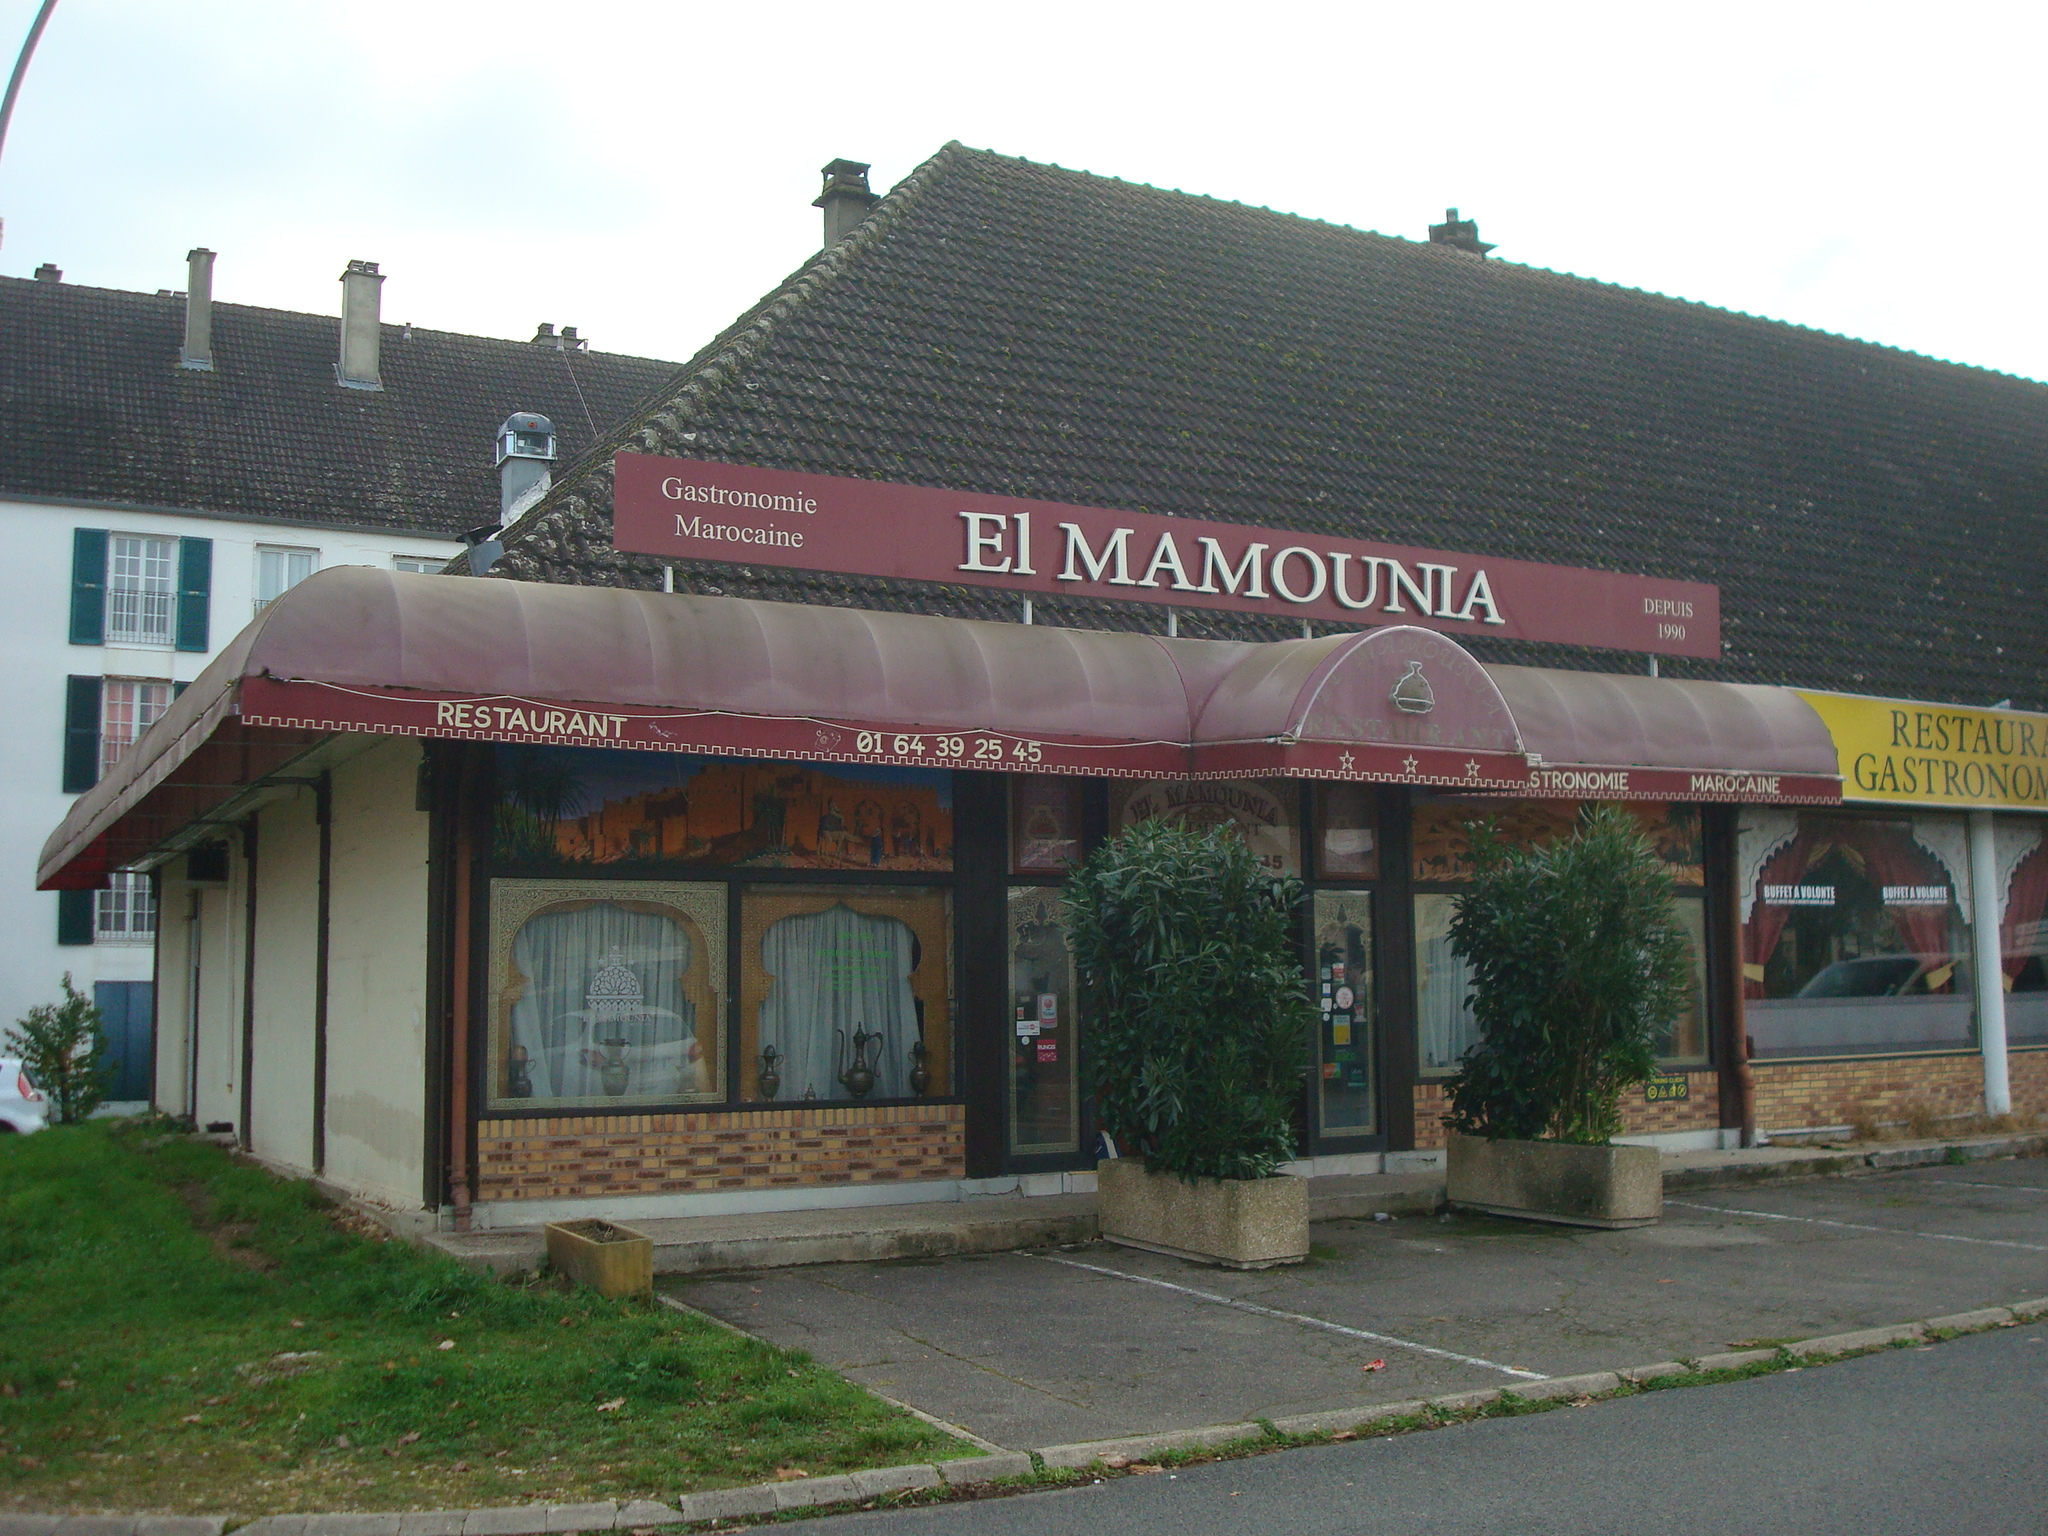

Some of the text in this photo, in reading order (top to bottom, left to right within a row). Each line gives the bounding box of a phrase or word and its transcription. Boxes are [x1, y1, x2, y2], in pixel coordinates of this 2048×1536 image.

[661, 476, 818, 515] Gastronomie
[675, 514, 804, 548] Marocaine
[957, 510, 1506, 626] El MAMOUNIA
[1643, 597, 1694, 618] DEPUIS
[1656, 622, 1687, 641] 1990
[437, 702, 628, 739] RESTAURANT
[856, 731, 1042, 763] 01 64 39 25 45
[1527, 770, 1781, 795] STRONOMIE MAROCAINE
[1164, 783, 1280, 827] MAMOUNIA
[1764, 885, 1793, 899] BUFFET
[1793, 886, 1801, 899] A
[1882, 886, 1909, 899] BUFFET
